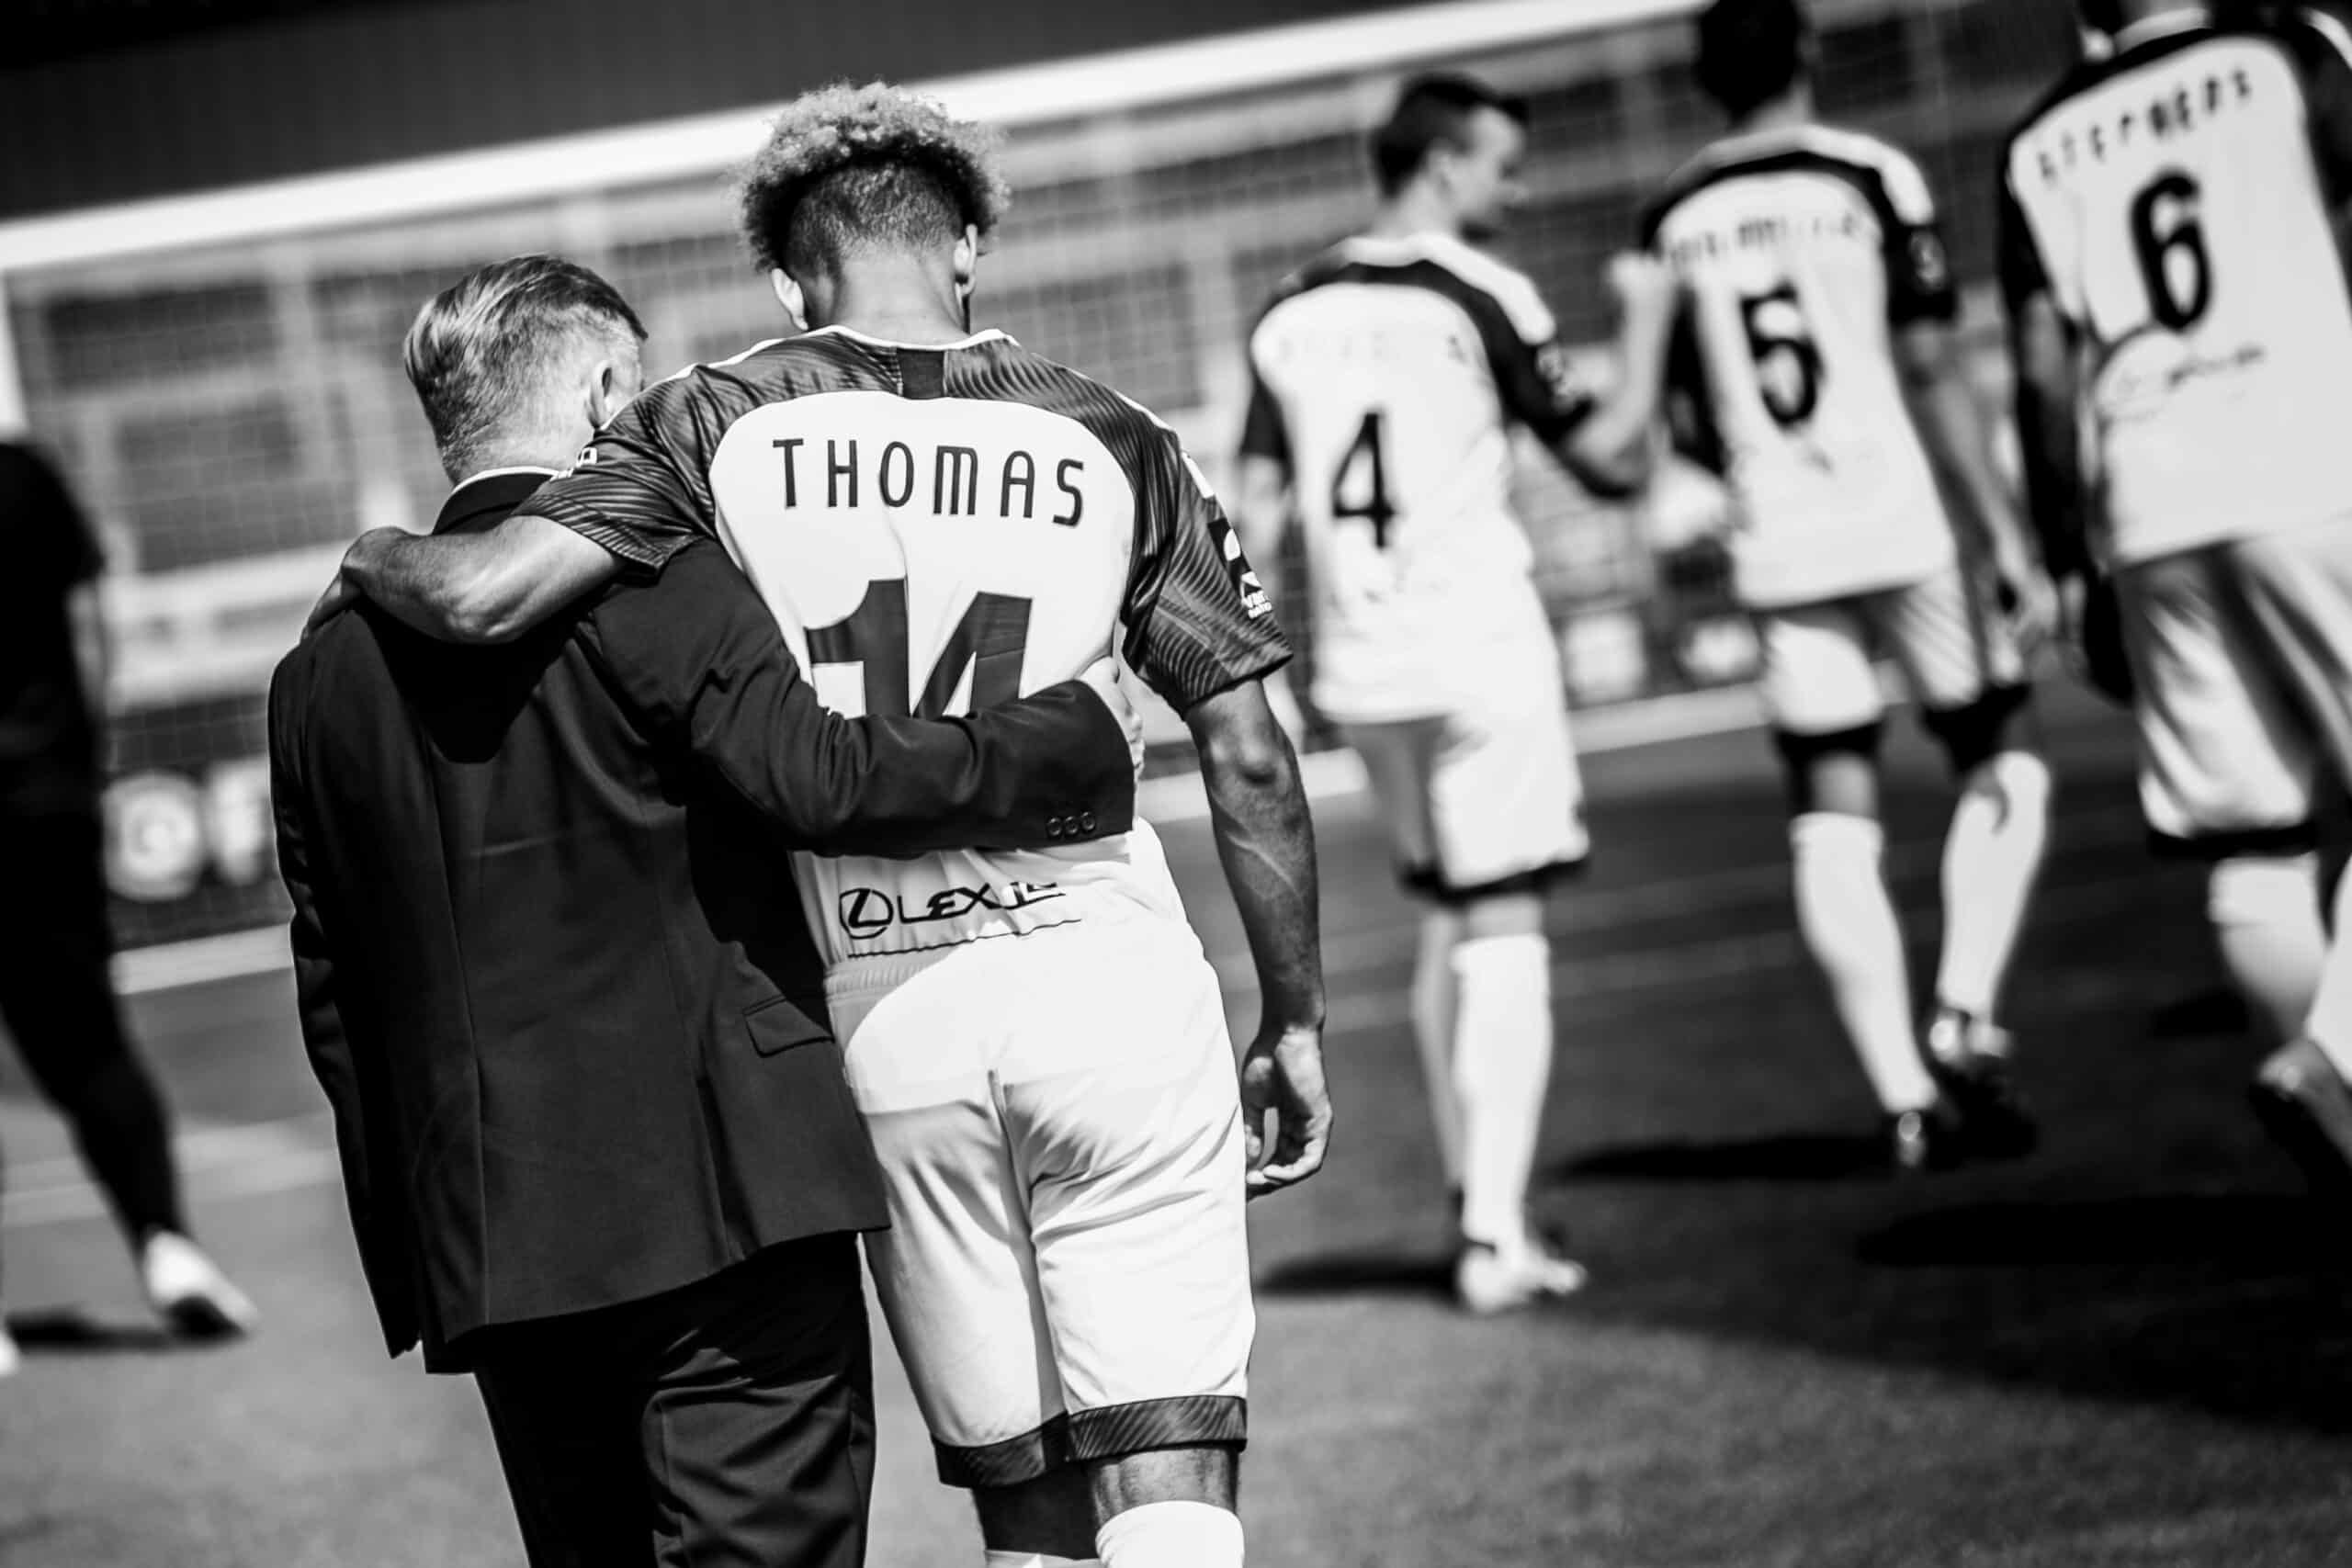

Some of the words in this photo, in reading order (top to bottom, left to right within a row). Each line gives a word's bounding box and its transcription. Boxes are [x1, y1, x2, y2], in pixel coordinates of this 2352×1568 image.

[2129, 167, 2213, 336] 6
[1737, 278, 1826, 433] 5
[773, 437, 1084, 528] THOMAS
[1330, 410, 1400, 551] 4
[804, 578, 1034, 718] 14
